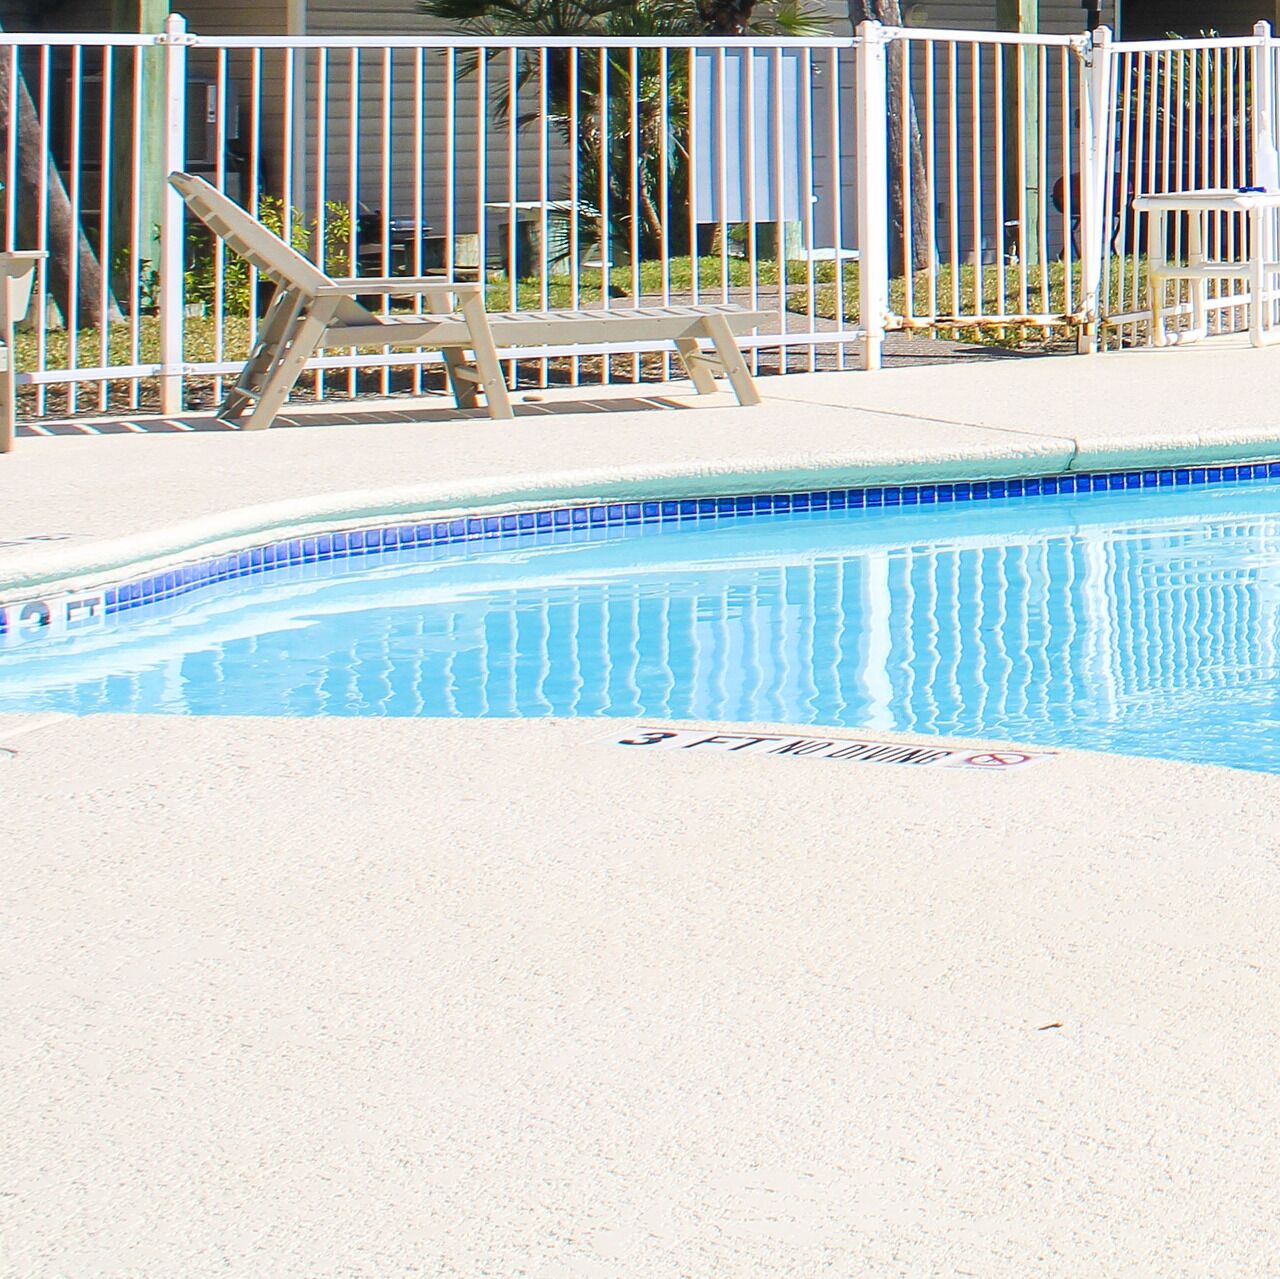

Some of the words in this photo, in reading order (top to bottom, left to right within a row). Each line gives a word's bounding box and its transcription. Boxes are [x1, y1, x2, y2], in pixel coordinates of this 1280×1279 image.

[618, 732, 678, 745] 3
[681, 735, 783, 751] FT
[768, 739, 834, 756] NO
[826, 743, 954, 765] DIVING
